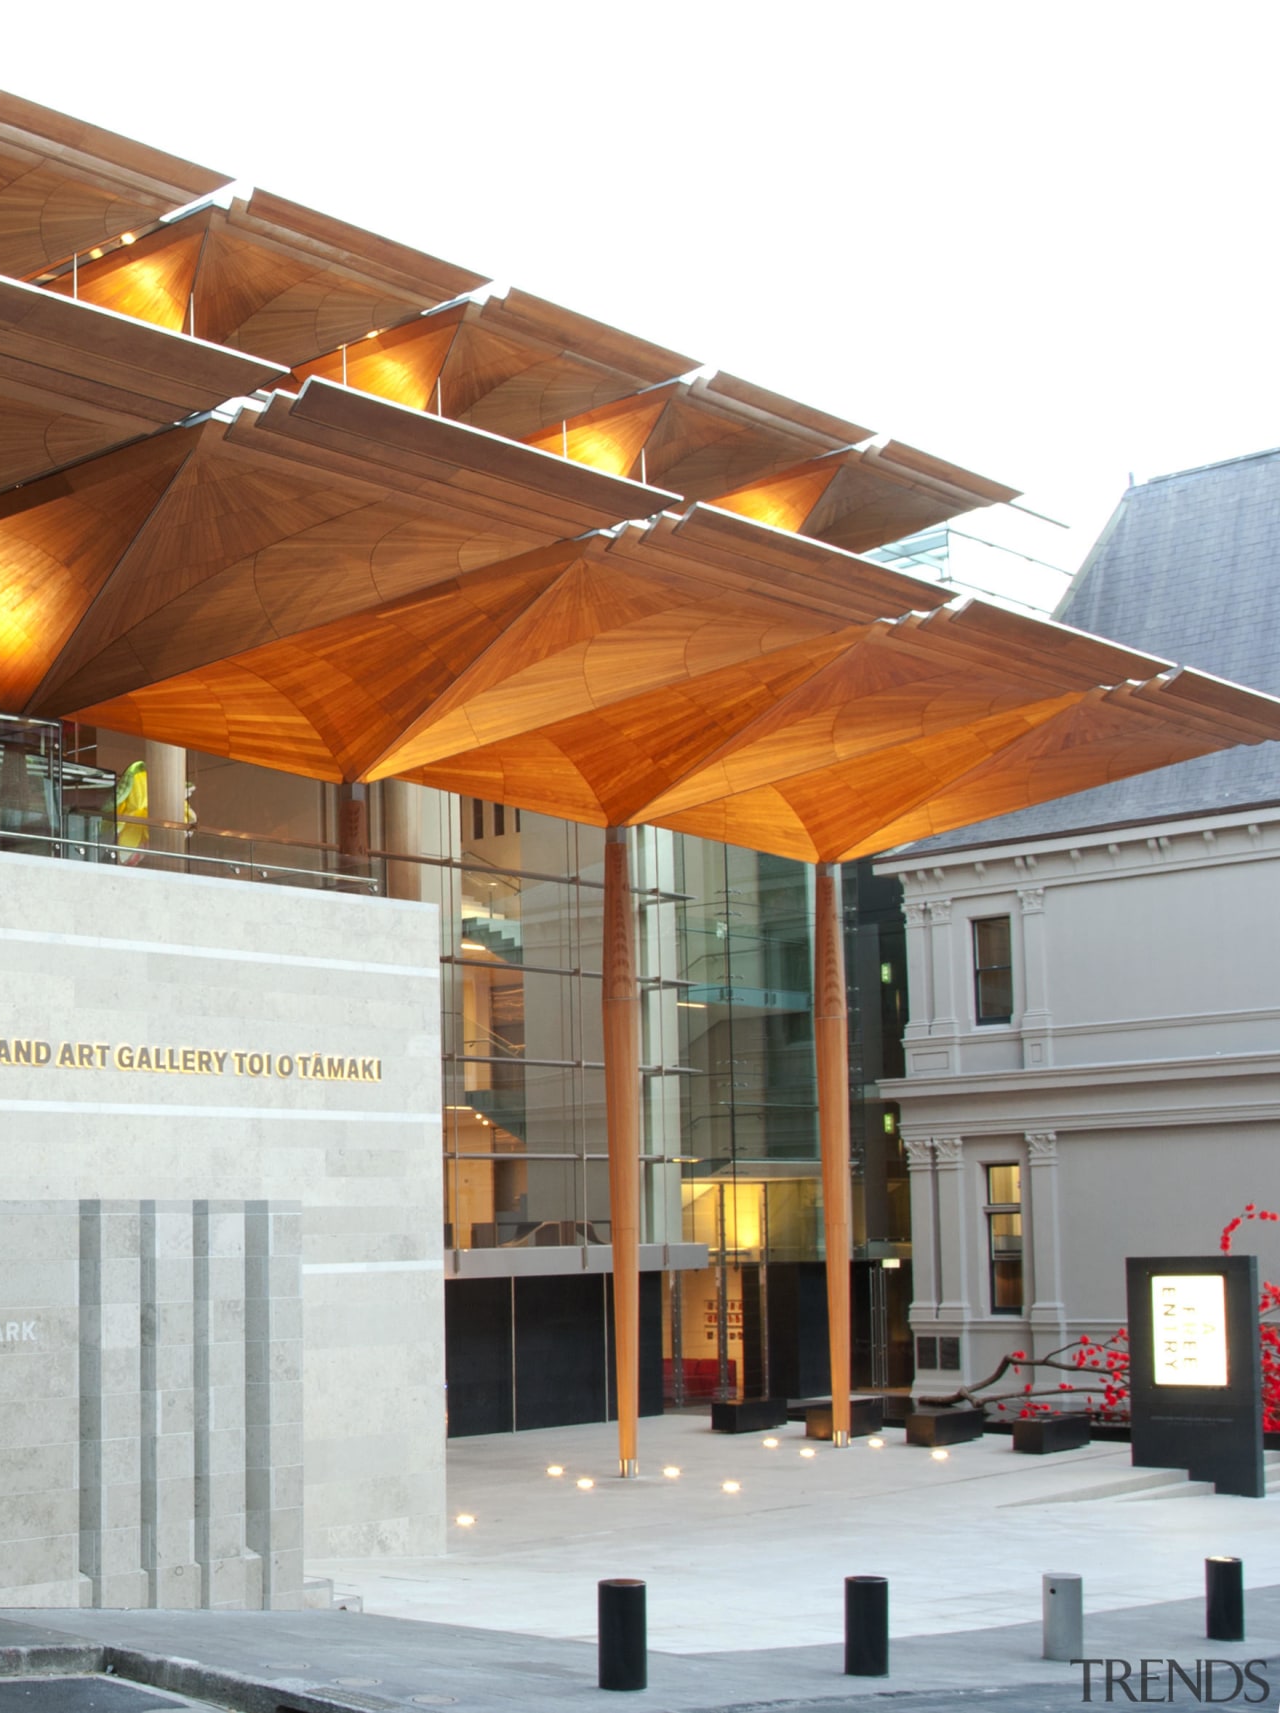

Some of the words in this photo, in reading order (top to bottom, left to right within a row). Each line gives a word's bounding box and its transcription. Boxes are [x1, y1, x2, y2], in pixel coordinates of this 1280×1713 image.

[57, 1042, 110, 1069] ART
[115, 1045, 227, 1075] GALLERY
[233, 1050, 271, 1077] TOI
[275, 1054, 294, 1079] O
[297, 1052, 382, 1082] TĀMAKI
[1162, 1287, 1177, 1369] ENTRY
